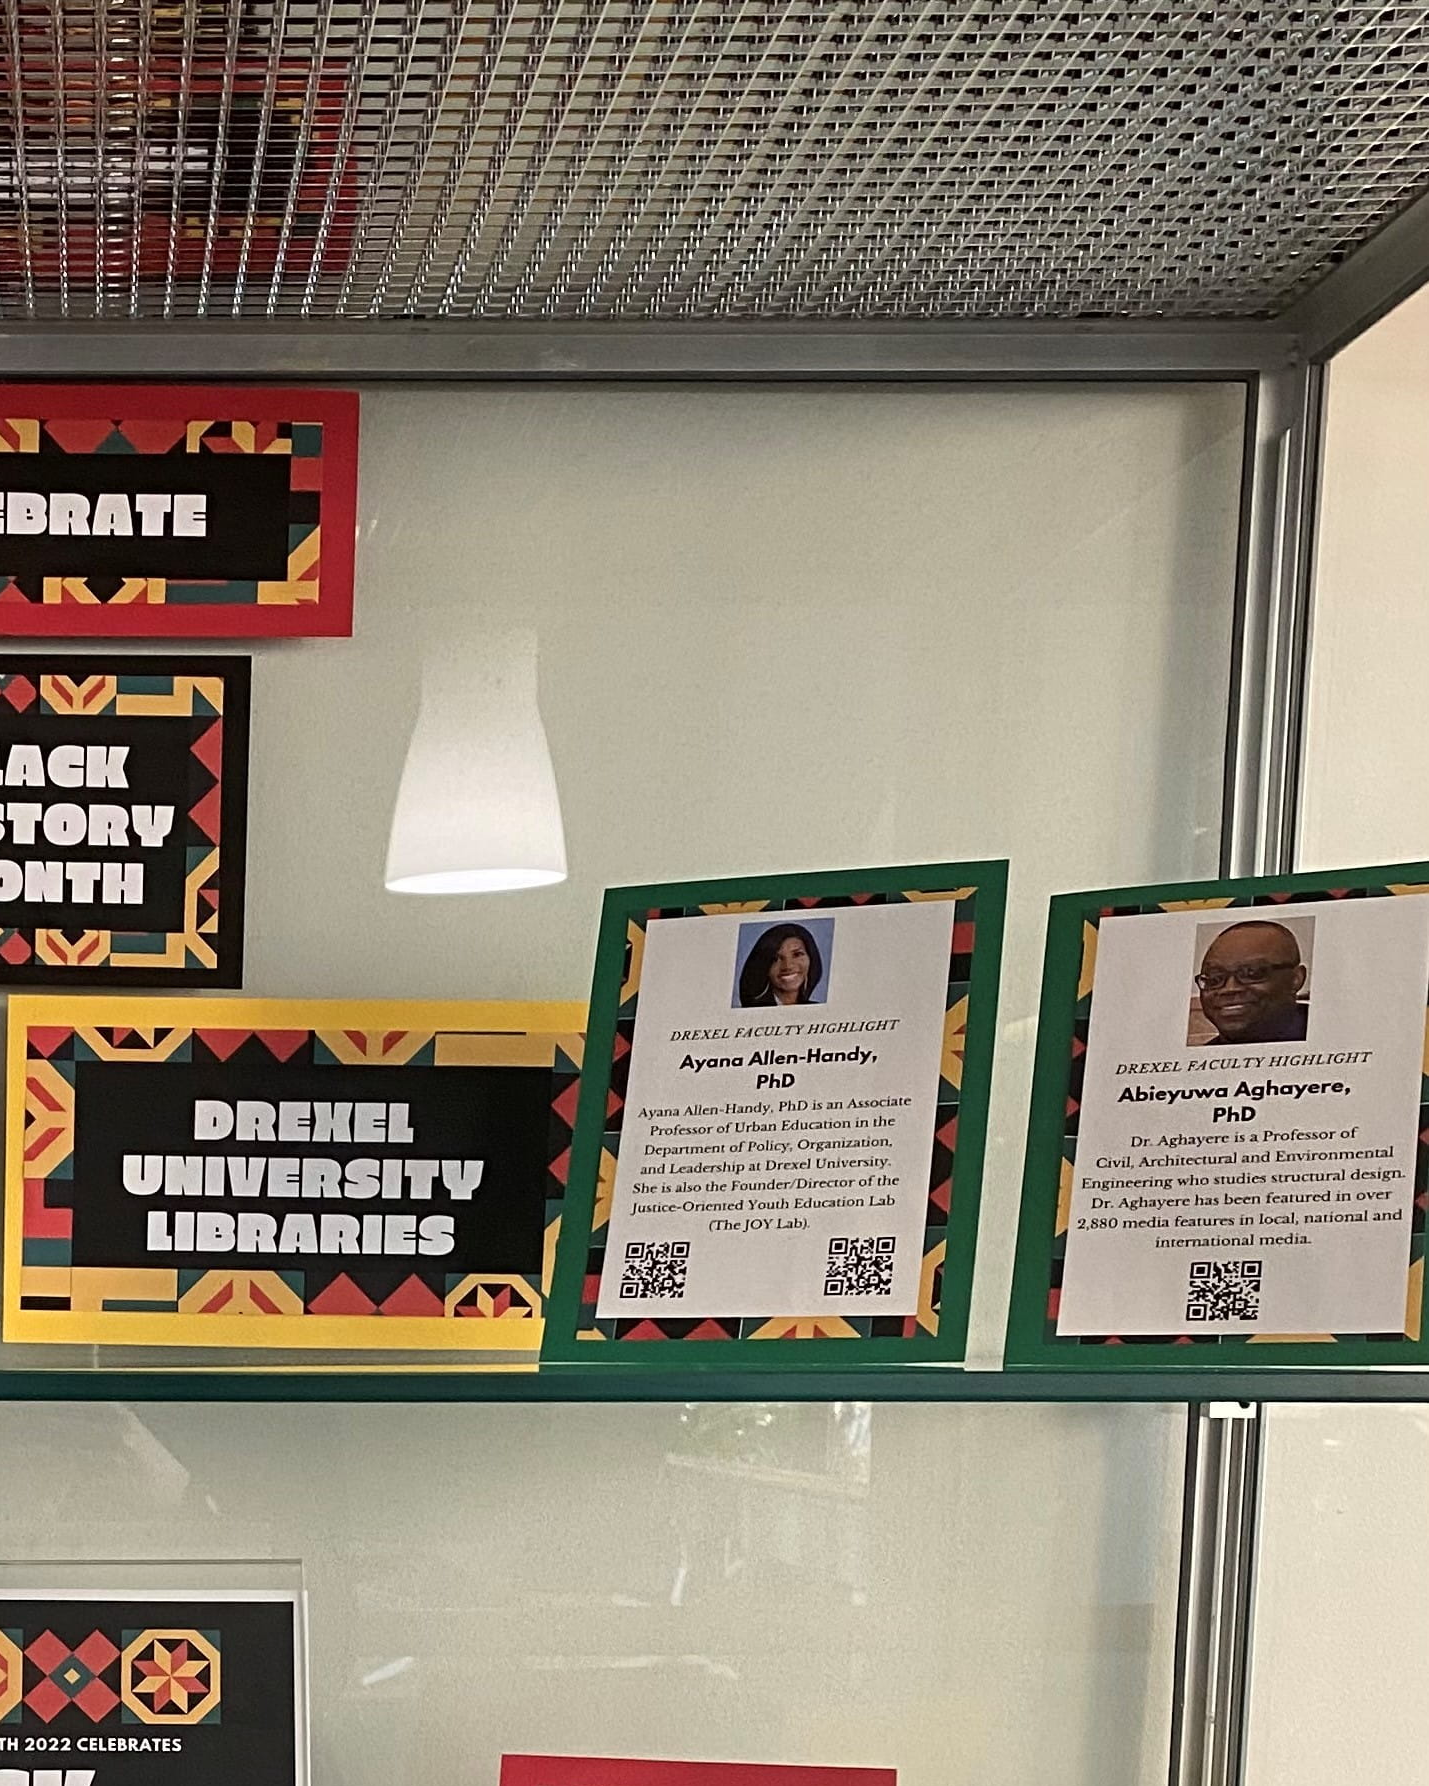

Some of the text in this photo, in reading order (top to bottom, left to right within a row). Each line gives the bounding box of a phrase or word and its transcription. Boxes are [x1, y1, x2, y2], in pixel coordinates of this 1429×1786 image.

[669, 1018, 900, 1042] DREXEL FACULTY HIGHLIGHT
[678, 1044, 878, 1073] Ayana Allen-Handy,
[755, 1072, 795, 1090] PhD
[1116, 1078, 1351, 1105] Abieyuwa Aghayere,
[193, 1099, 414, 1144] DREXEL
[1211, 1104, 1256, 1123] PhD
[122, 1154, 484, 1201] UNIVERSITY
[639, 1155, 891, 1175] and Leadership at Drexel University.
[146, 1210, 455, 1256] LIBRARIES
[24, 1736, 71, 1751] 2022
[76, 1736, 182, 1752] CELEBRATES
